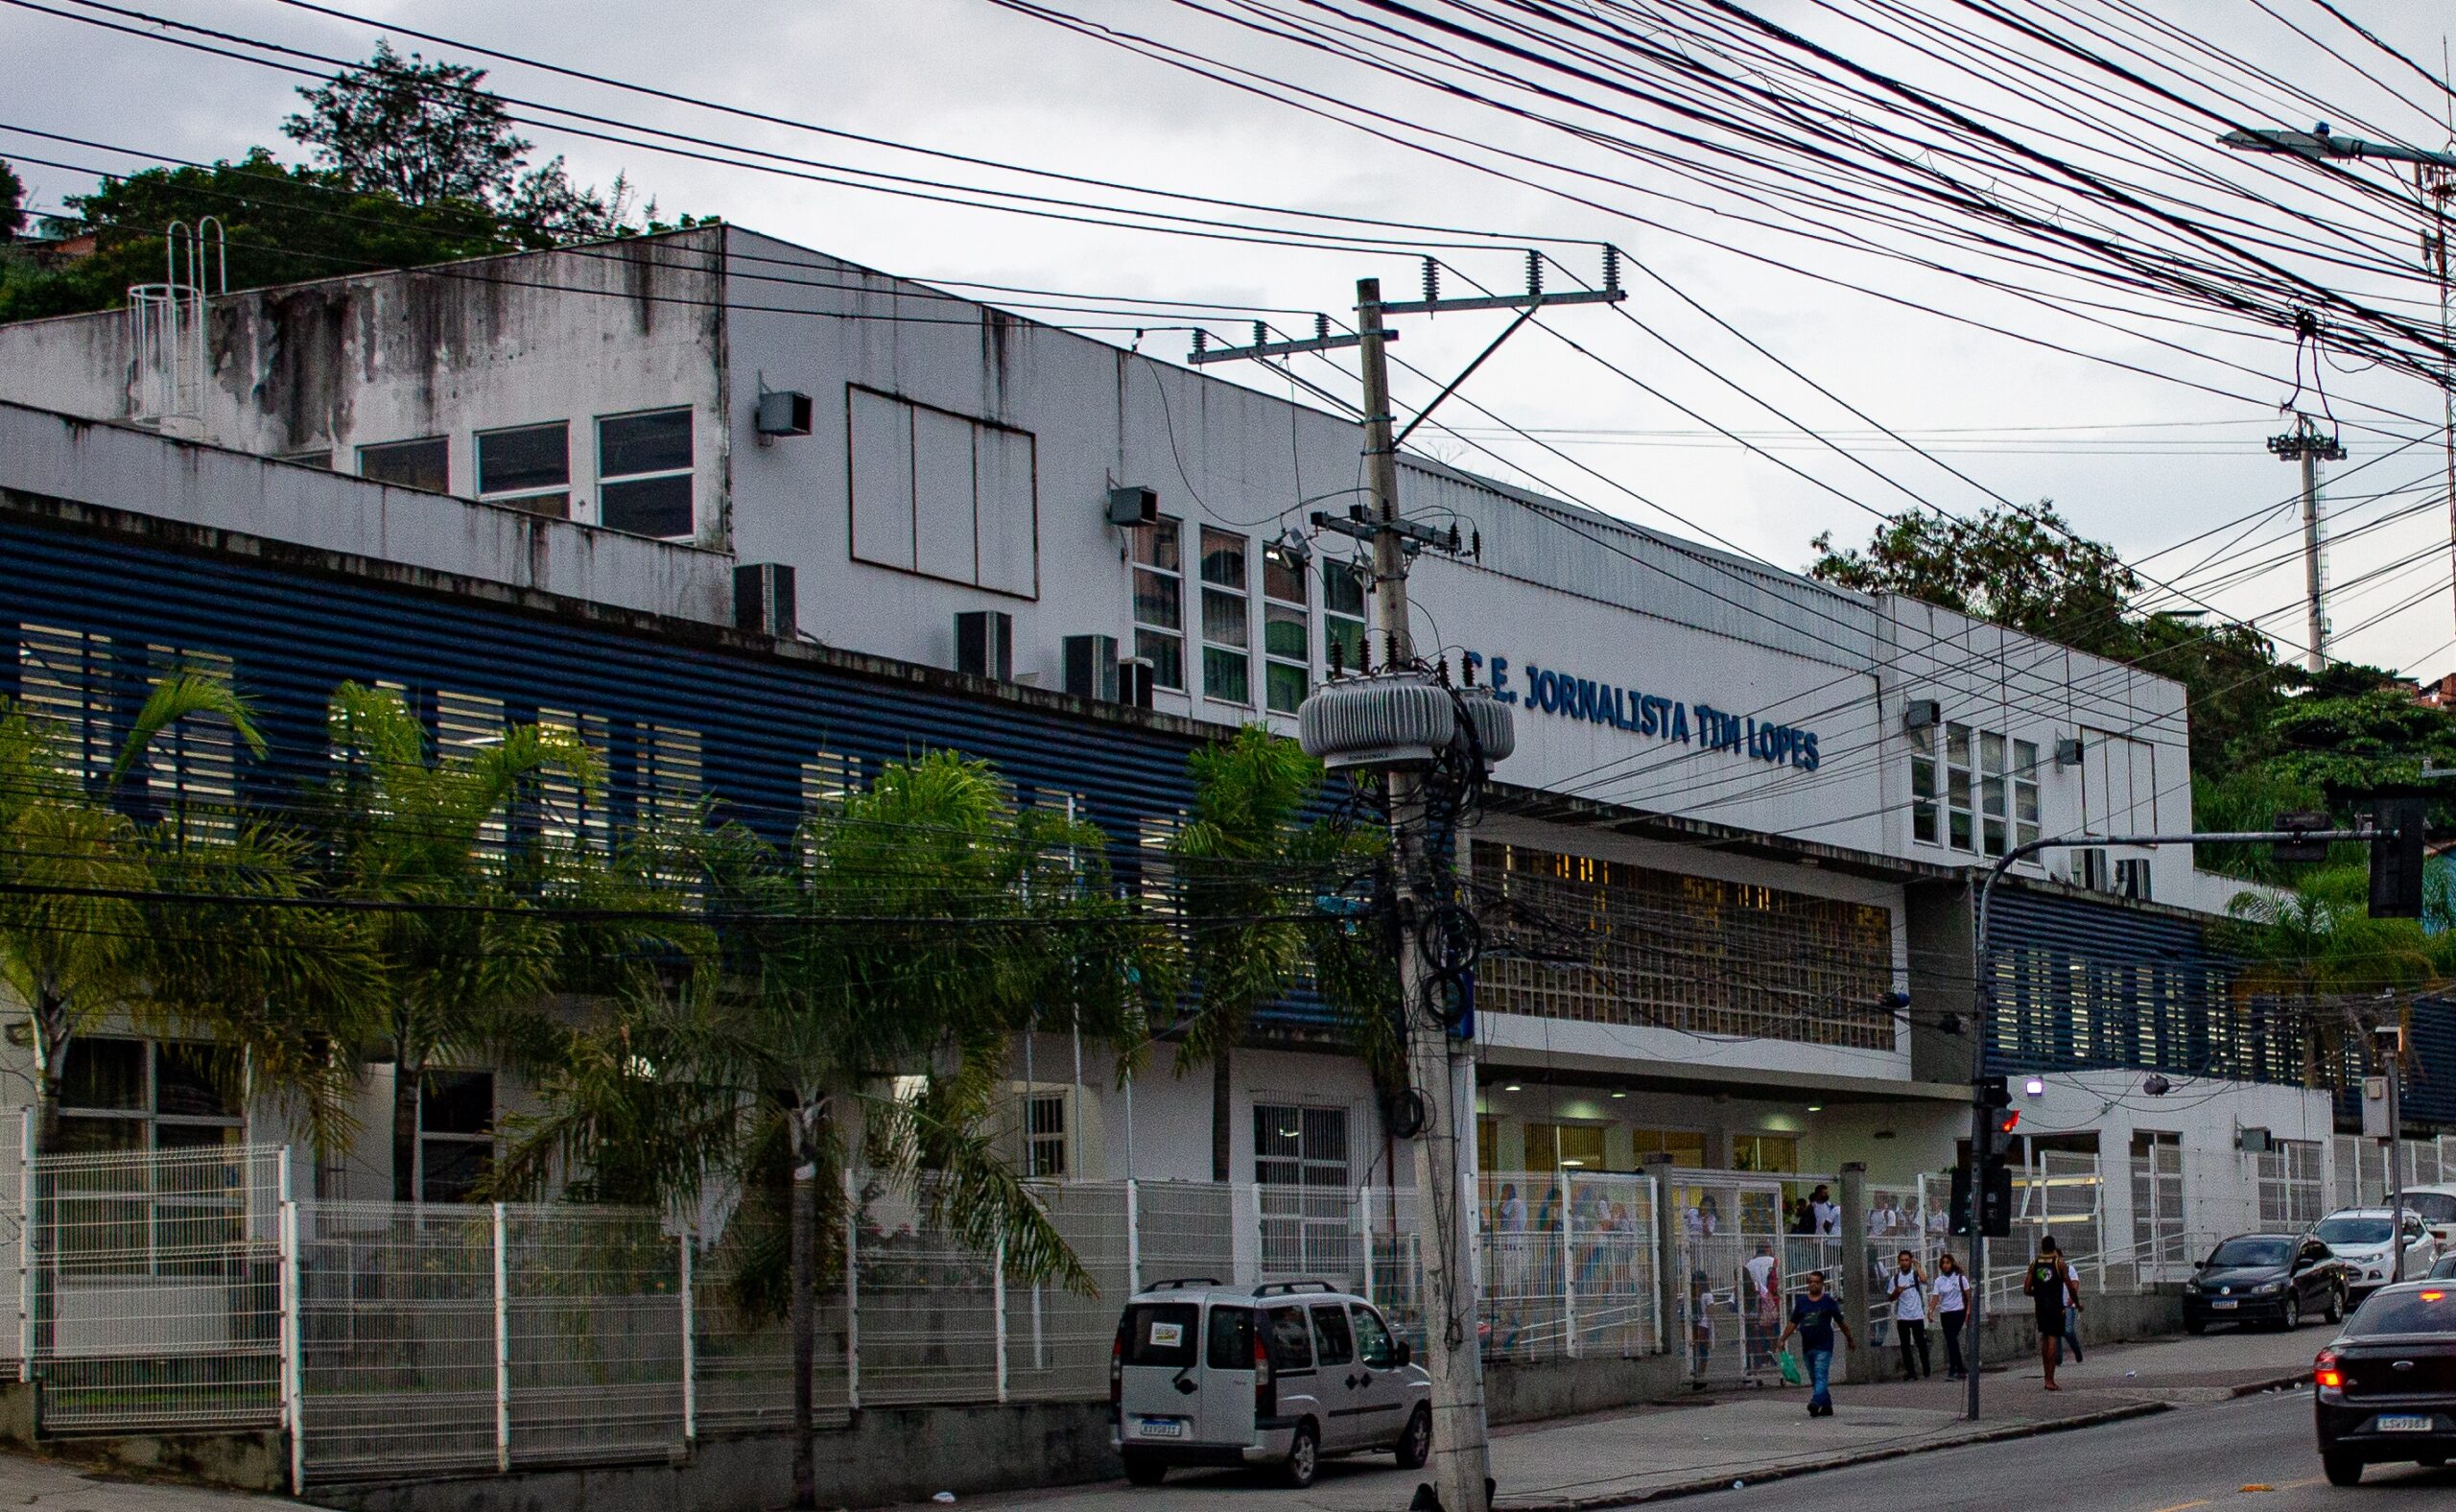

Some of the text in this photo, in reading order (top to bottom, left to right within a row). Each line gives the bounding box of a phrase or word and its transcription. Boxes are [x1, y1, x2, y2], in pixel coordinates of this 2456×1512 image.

[1524, 666, 1690, 744] JORNALISTA
[1693, 705, 1741, 755] TIM
[1747, 717, 1820, 771] LOPES
